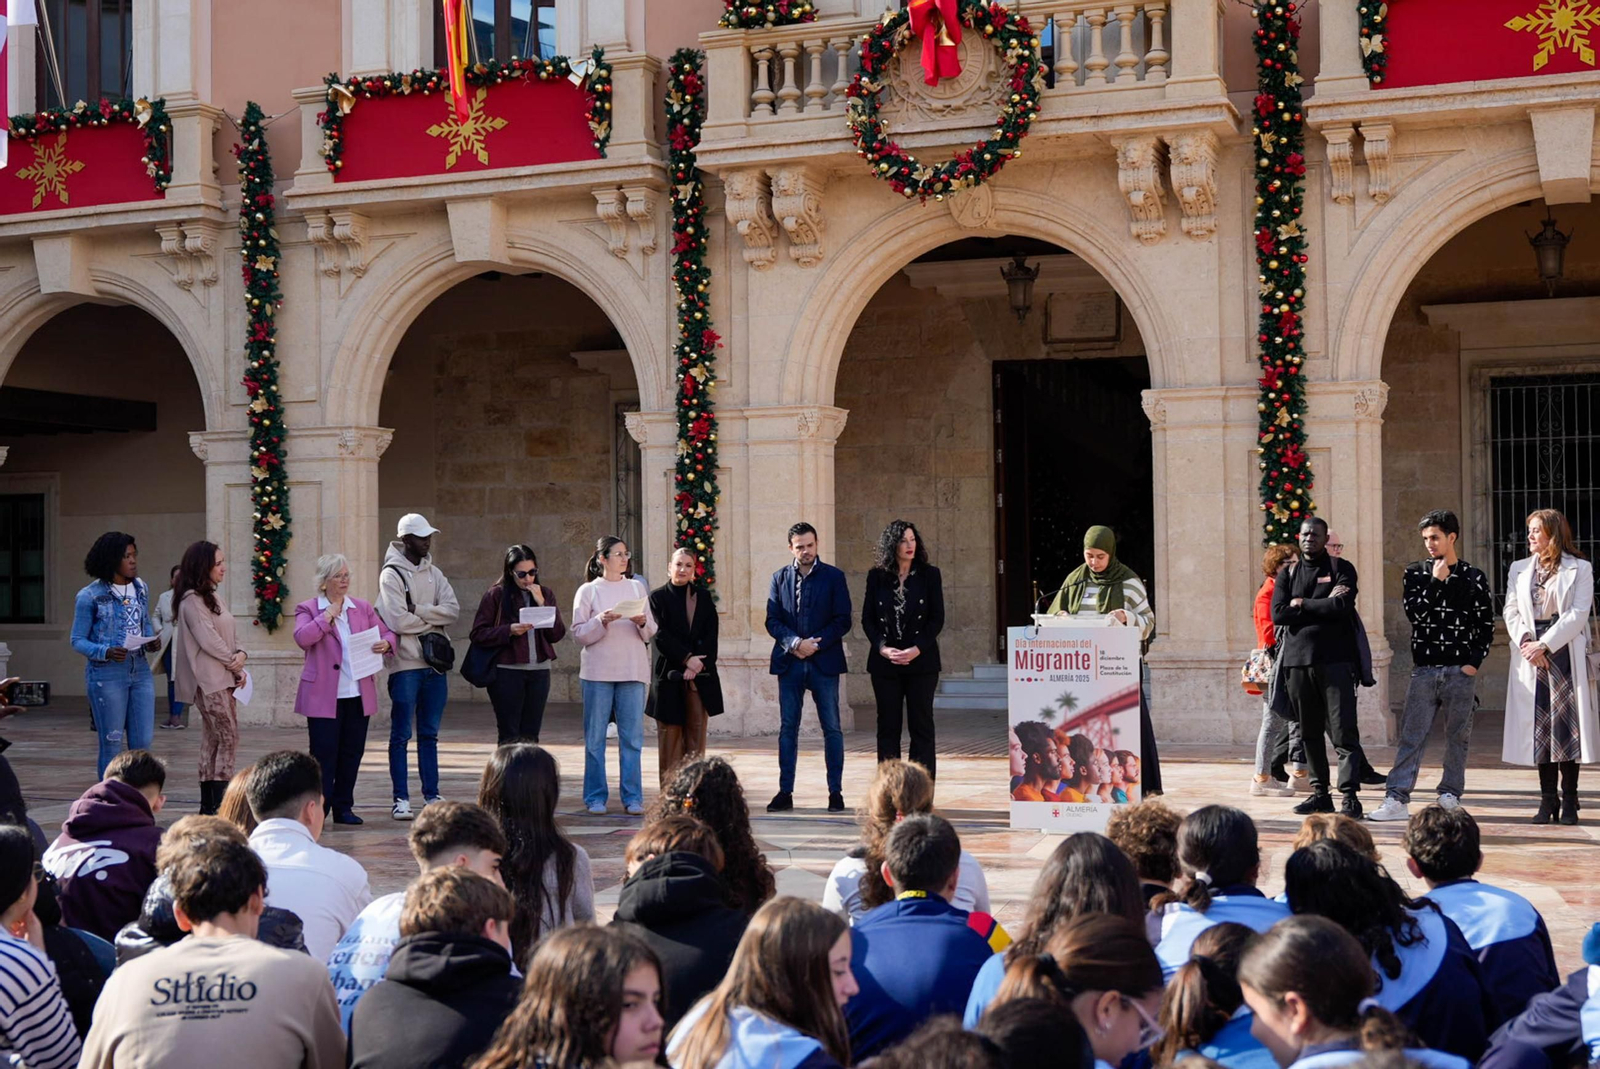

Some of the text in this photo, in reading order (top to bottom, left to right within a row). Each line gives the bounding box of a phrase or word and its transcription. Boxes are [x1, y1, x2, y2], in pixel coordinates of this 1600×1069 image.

[1080, 639, 1092, 648] del
[1015, 649, 1091, 672] Migrante
[1075, 674, 1090, 683] 2025
